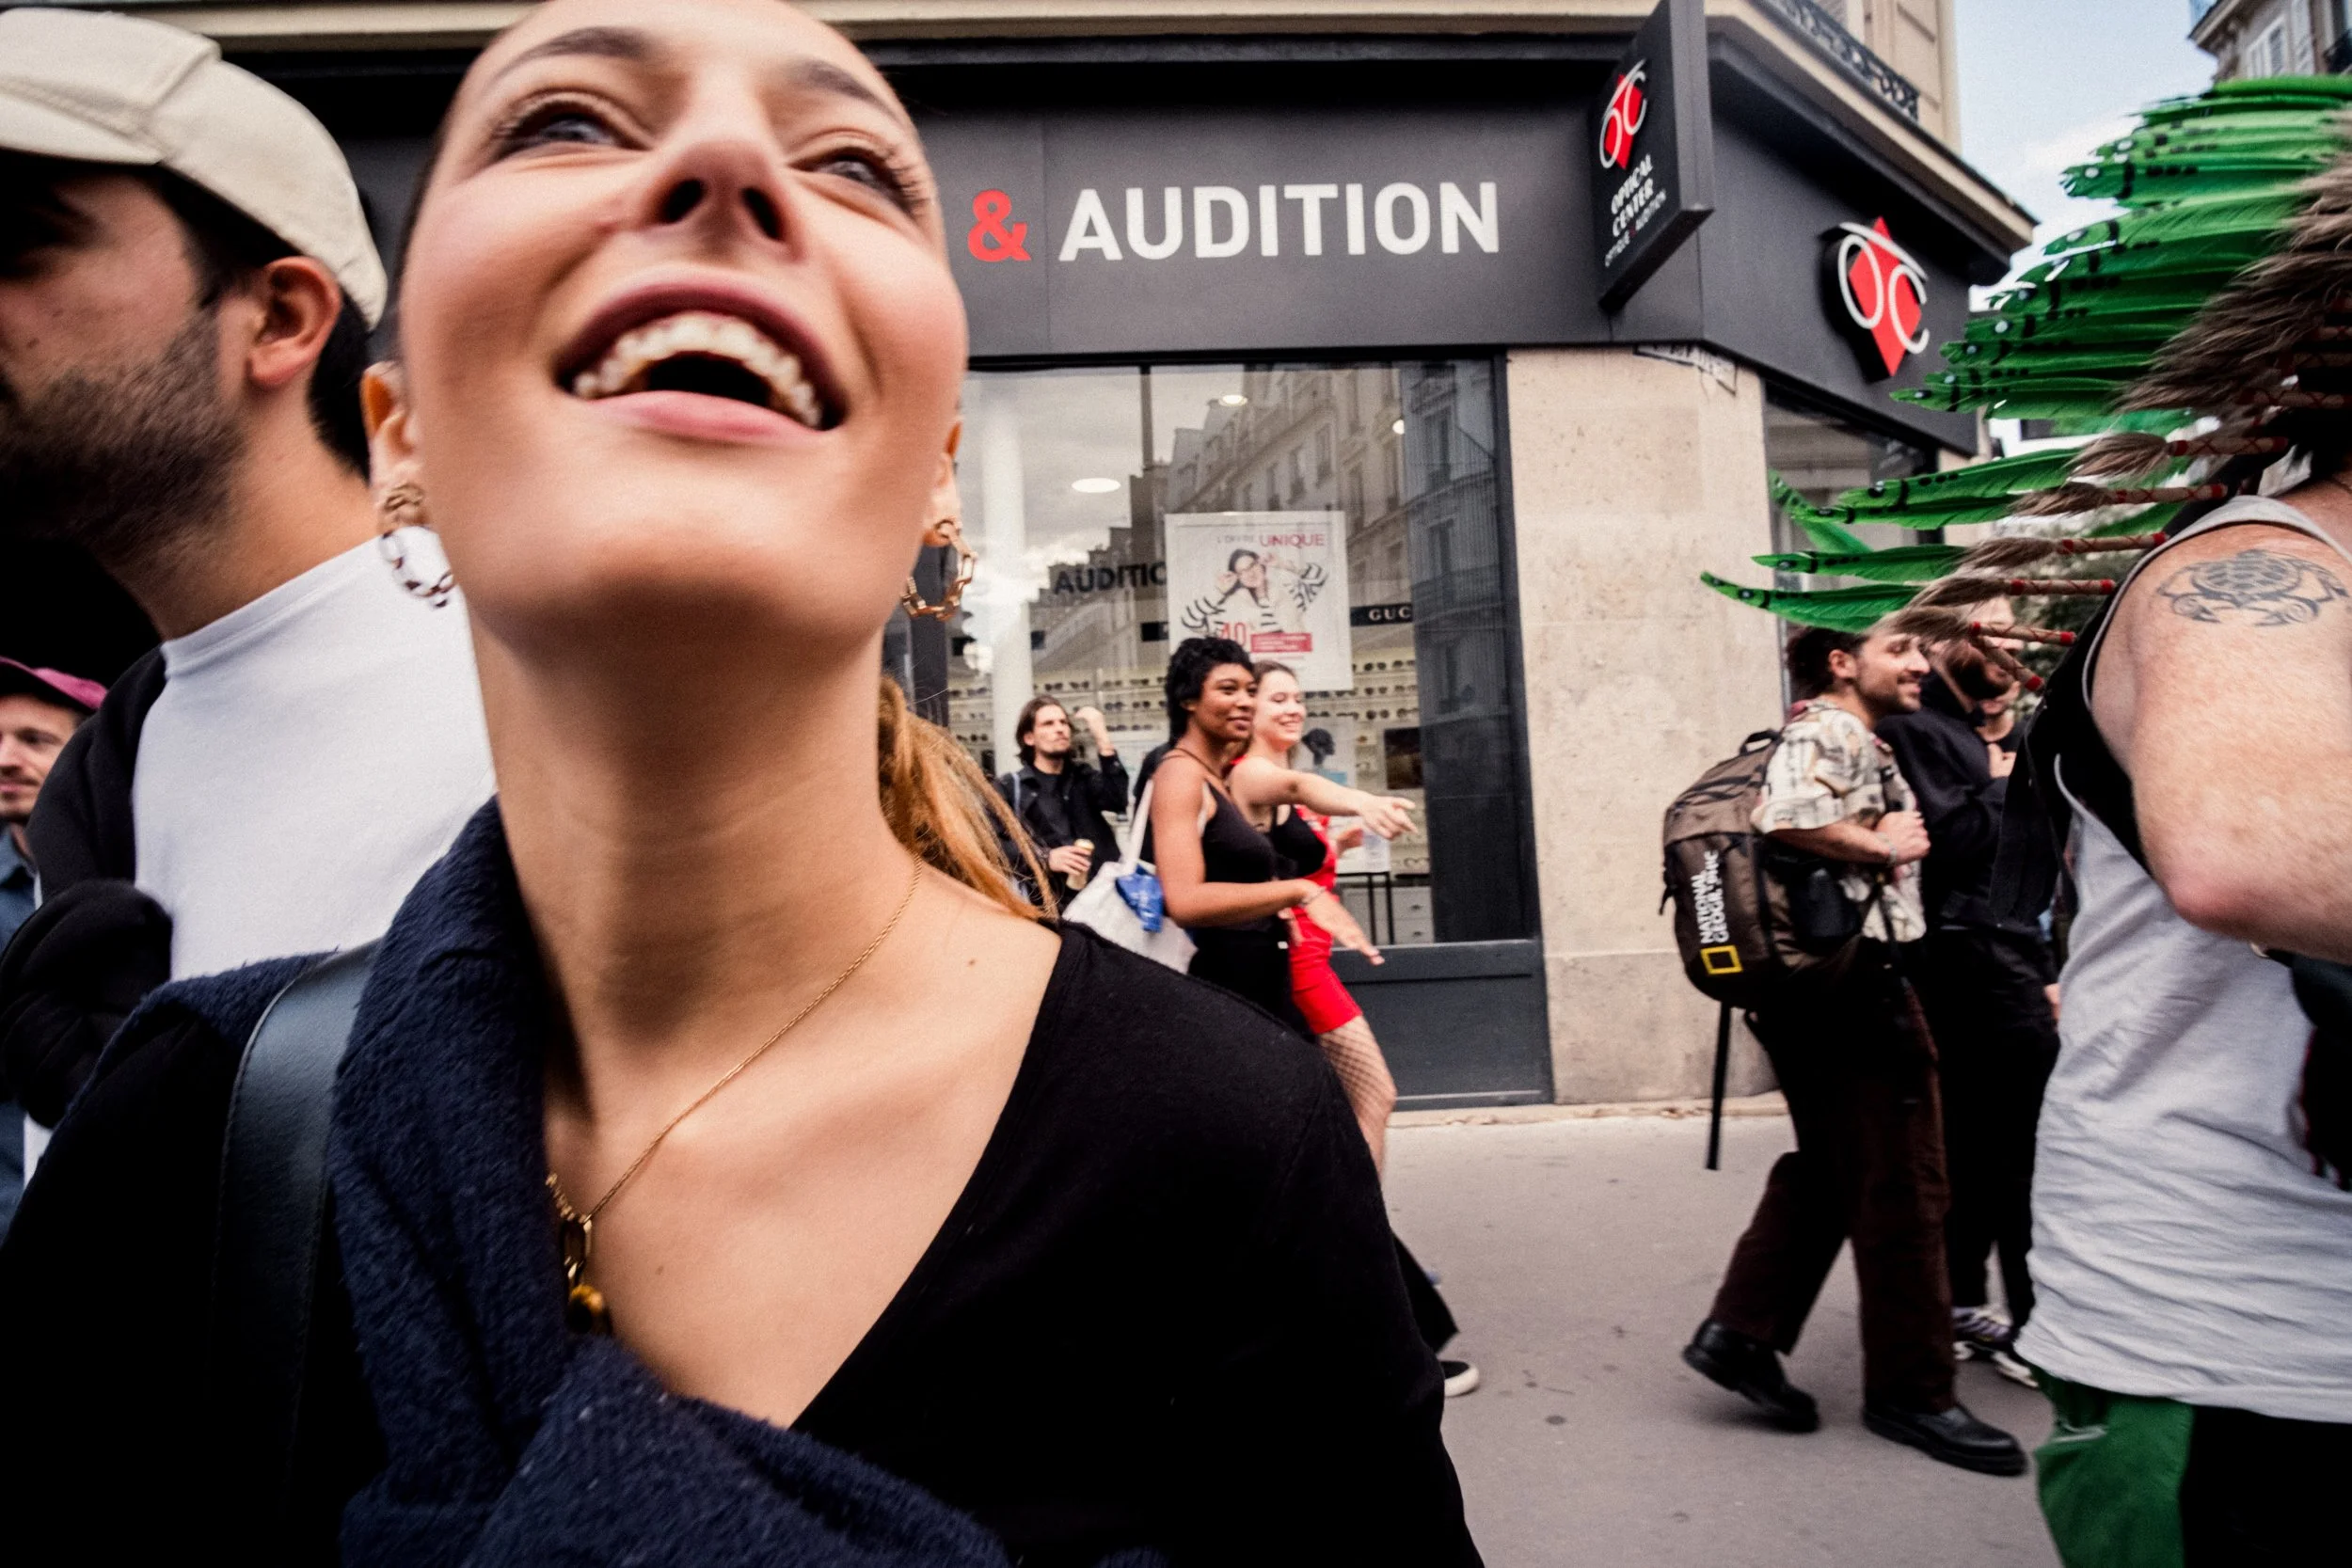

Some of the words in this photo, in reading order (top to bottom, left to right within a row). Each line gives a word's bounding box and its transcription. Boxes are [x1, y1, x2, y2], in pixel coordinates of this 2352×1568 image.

[1611, 153, 1653, 214] OPTICAL
[1613, 178, 1654, 237] CENTER
[967, 188, 1032, 262] &
[1058, 182, 1500, 262] AUDITION
[1259, 533, 1325, 548] UNIQUE
[1691, 870, 1713, 943] NATIONAL
